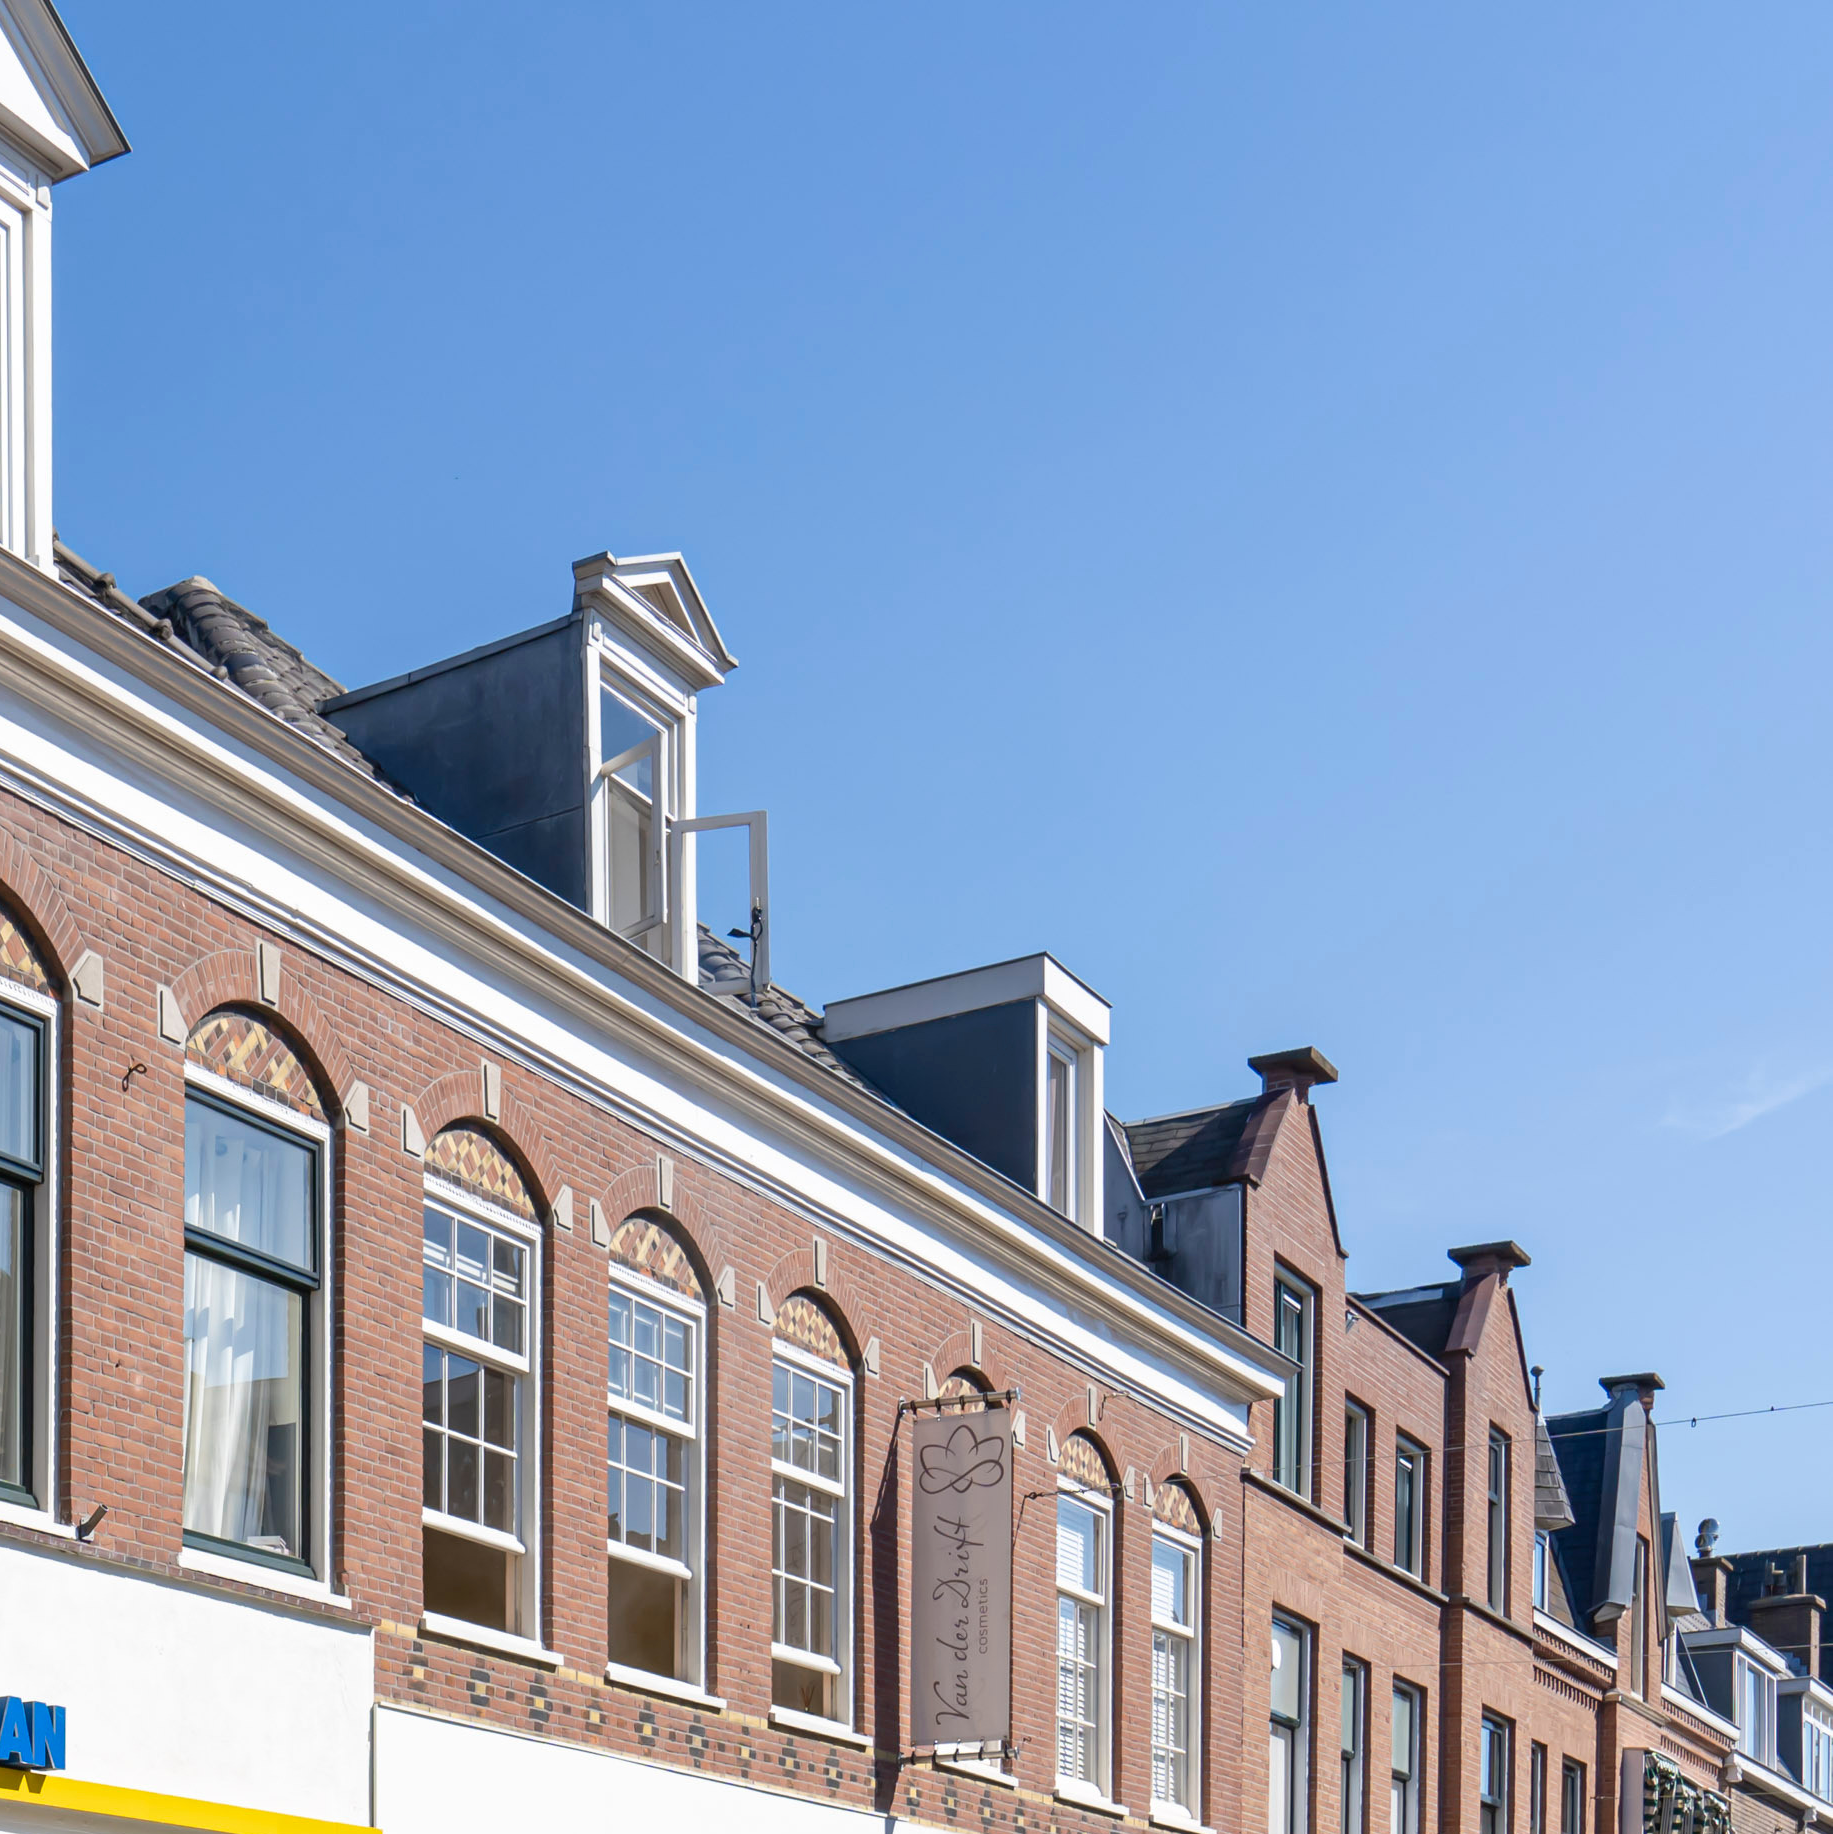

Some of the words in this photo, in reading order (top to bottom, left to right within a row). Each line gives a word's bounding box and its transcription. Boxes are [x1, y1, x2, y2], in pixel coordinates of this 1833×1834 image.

[932, 1515, 984, 1609] Drift
[935, 1615, 970, 1661] der
[978, 1578, 988, 1655] cosmetics
[933, 1681, 970, 1726] Van
